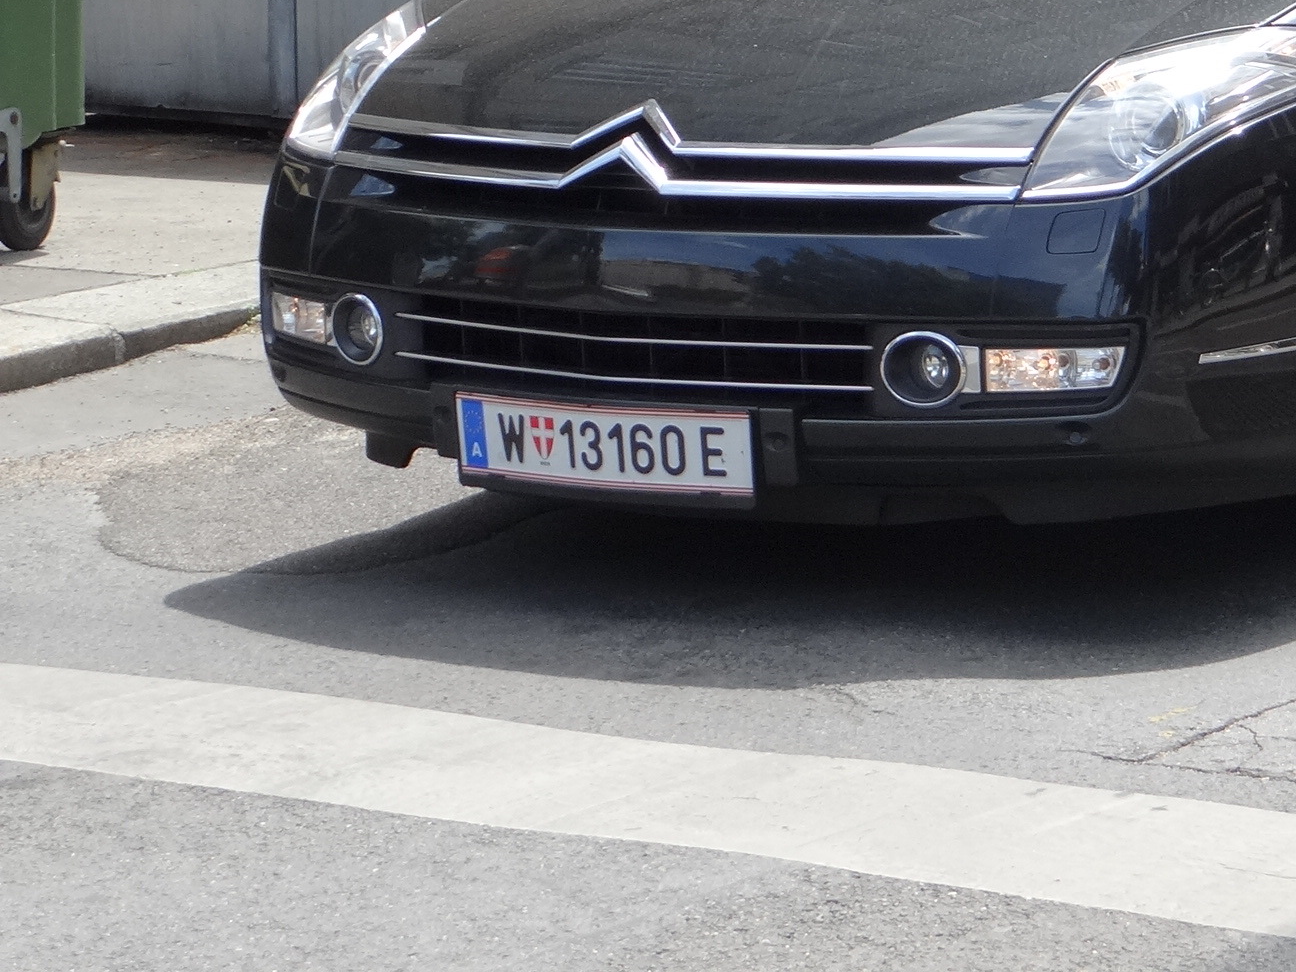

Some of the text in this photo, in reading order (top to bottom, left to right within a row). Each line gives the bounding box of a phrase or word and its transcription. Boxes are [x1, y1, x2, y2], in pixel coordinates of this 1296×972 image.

[471, 441, 483, 458] A
[497, 412, 729, 478] W 13160 E
